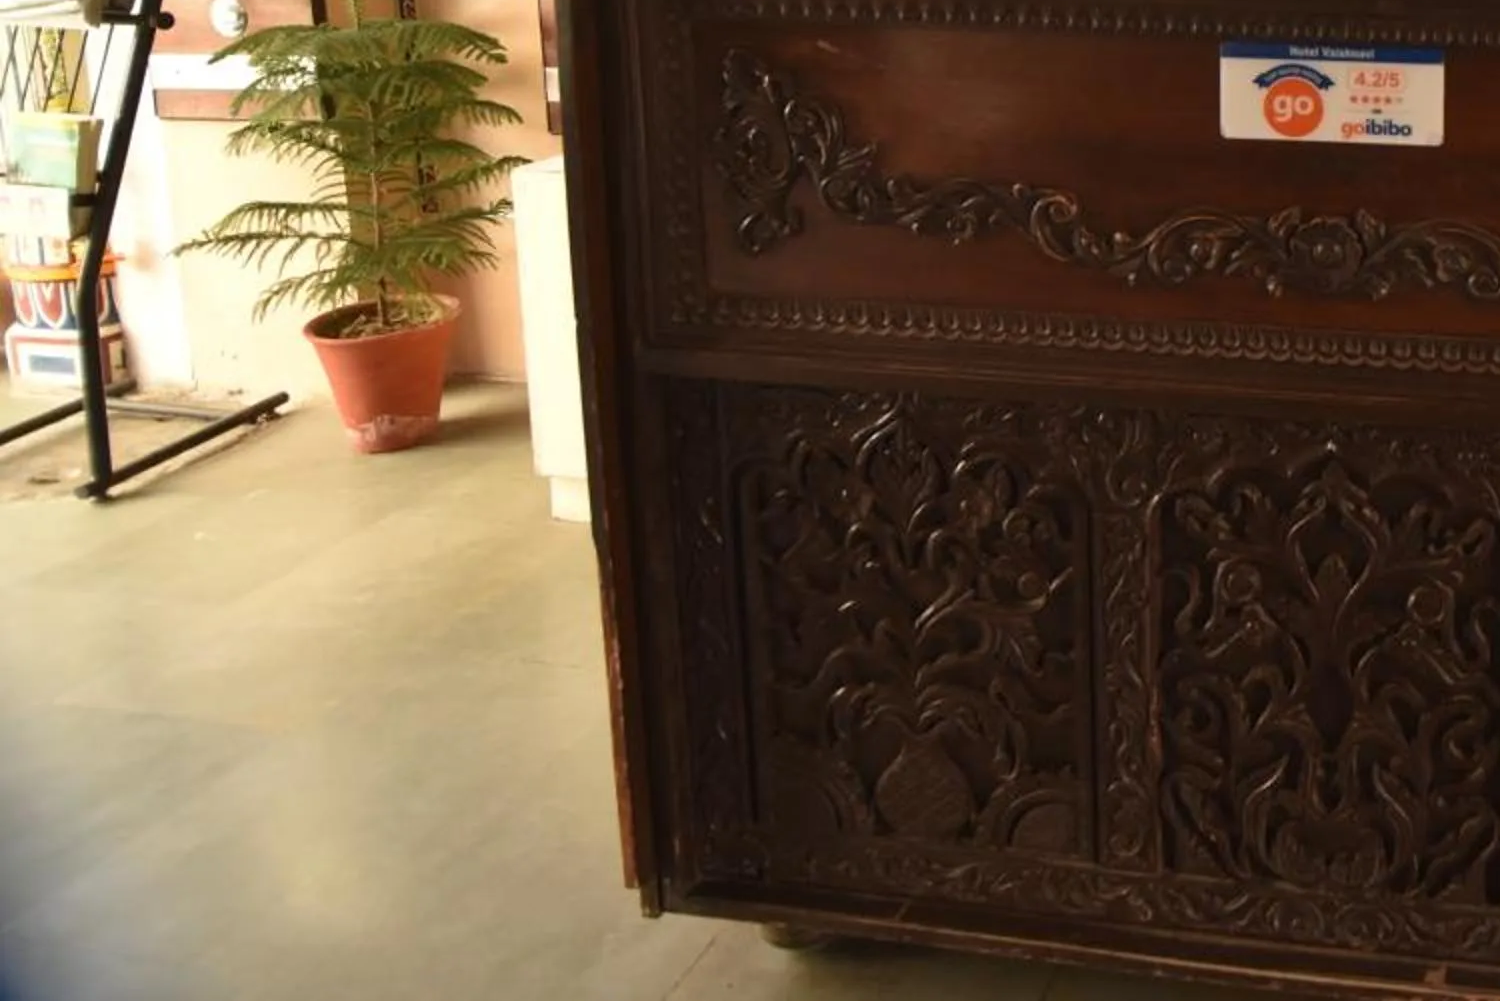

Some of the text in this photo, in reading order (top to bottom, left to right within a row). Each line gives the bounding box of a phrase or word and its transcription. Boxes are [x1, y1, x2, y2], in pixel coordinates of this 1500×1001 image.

[1289, 46, 1320, 57] Hotel
[1353, 71, 1401, 88] 4.2/5
[1273, 94, 1315, 122] go
[1341, 118, 1412, 138] goibibo
